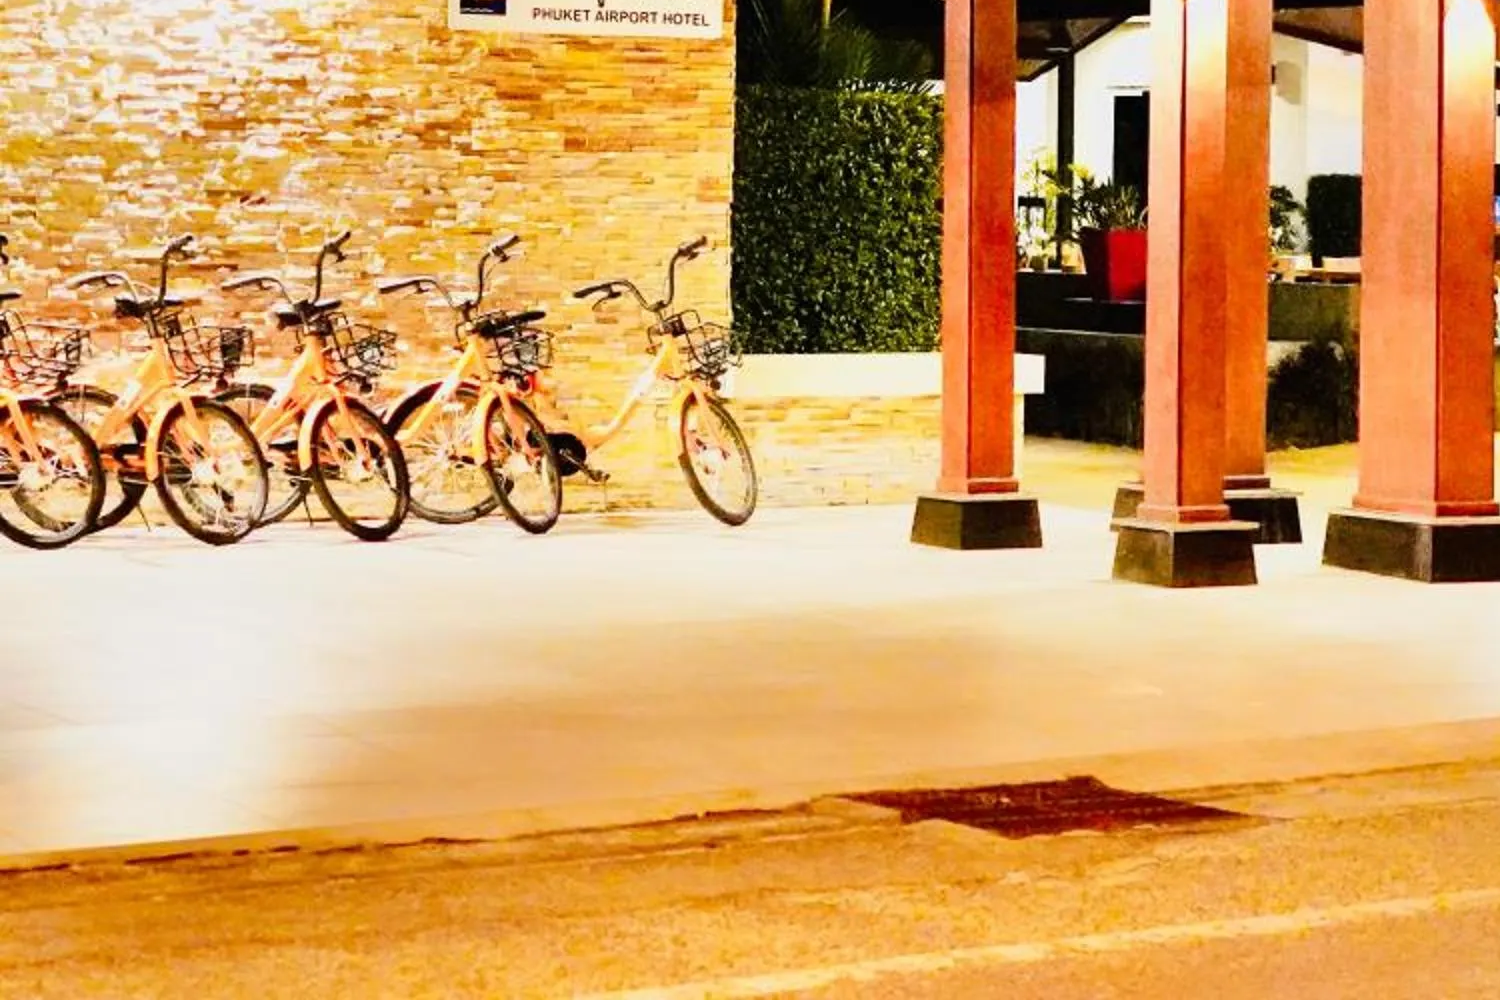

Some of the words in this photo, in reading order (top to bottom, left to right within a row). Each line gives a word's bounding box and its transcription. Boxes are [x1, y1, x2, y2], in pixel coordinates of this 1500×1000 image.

[533, 7, 591, 22] PHUKET
[594, 9, 658, 25] AIRPORT
[663, 12, 711, 27] HOTEL
